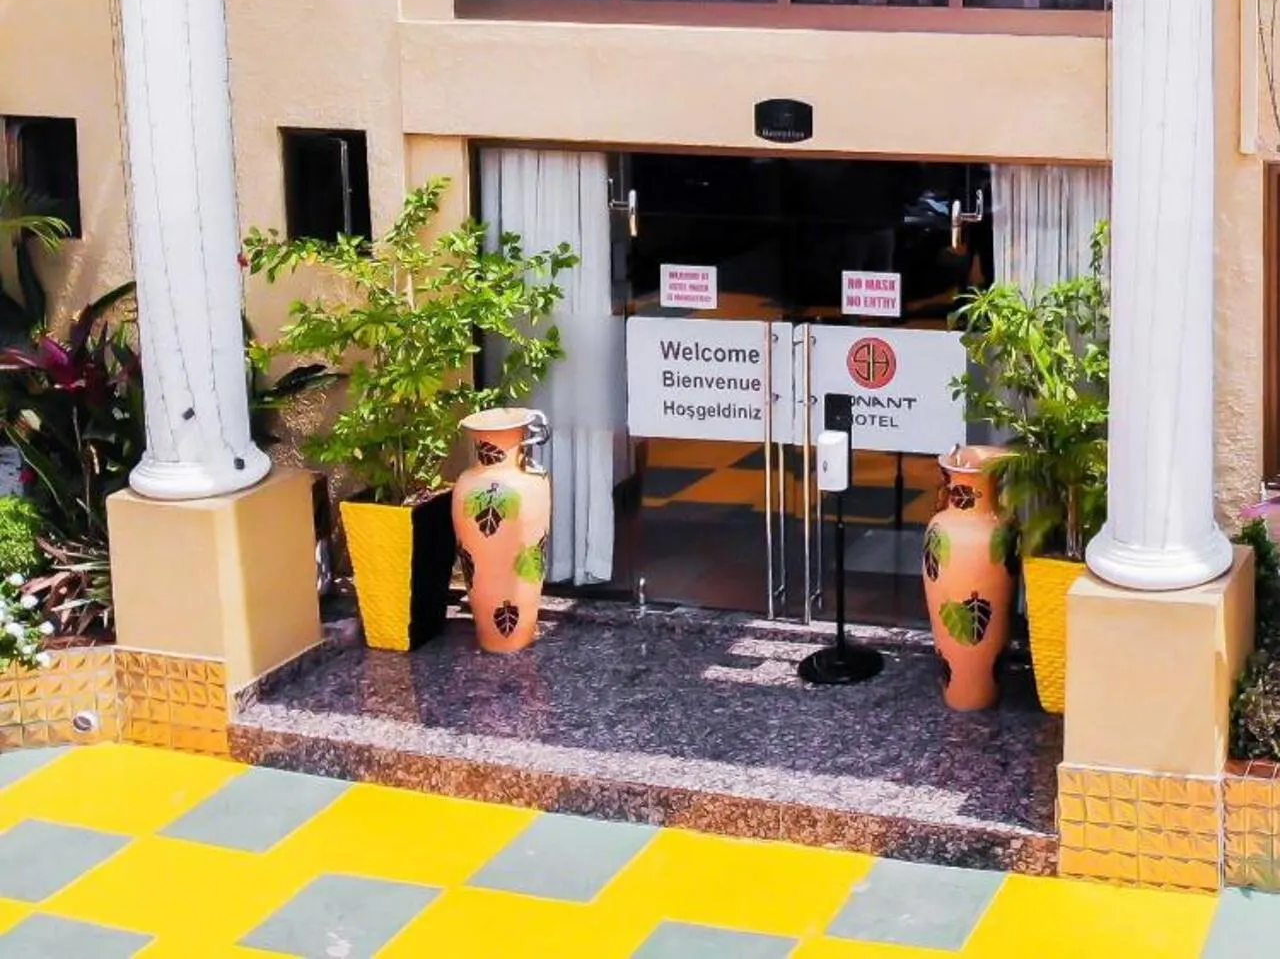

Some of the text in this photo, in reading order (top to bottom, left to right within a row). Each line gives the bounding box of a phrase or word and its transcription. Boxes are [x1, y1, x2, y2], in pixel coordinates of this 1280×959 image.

[847, 278, 863, 290] NO
[846, 295, 862, 307] NO
[660, 340, 760, 363] Welcome
[662, 370, 762, 391] Bienvenue
[663, 400, 762, 421] Hoşgeldiniz
[851, 414, 899, 427] OTEL
